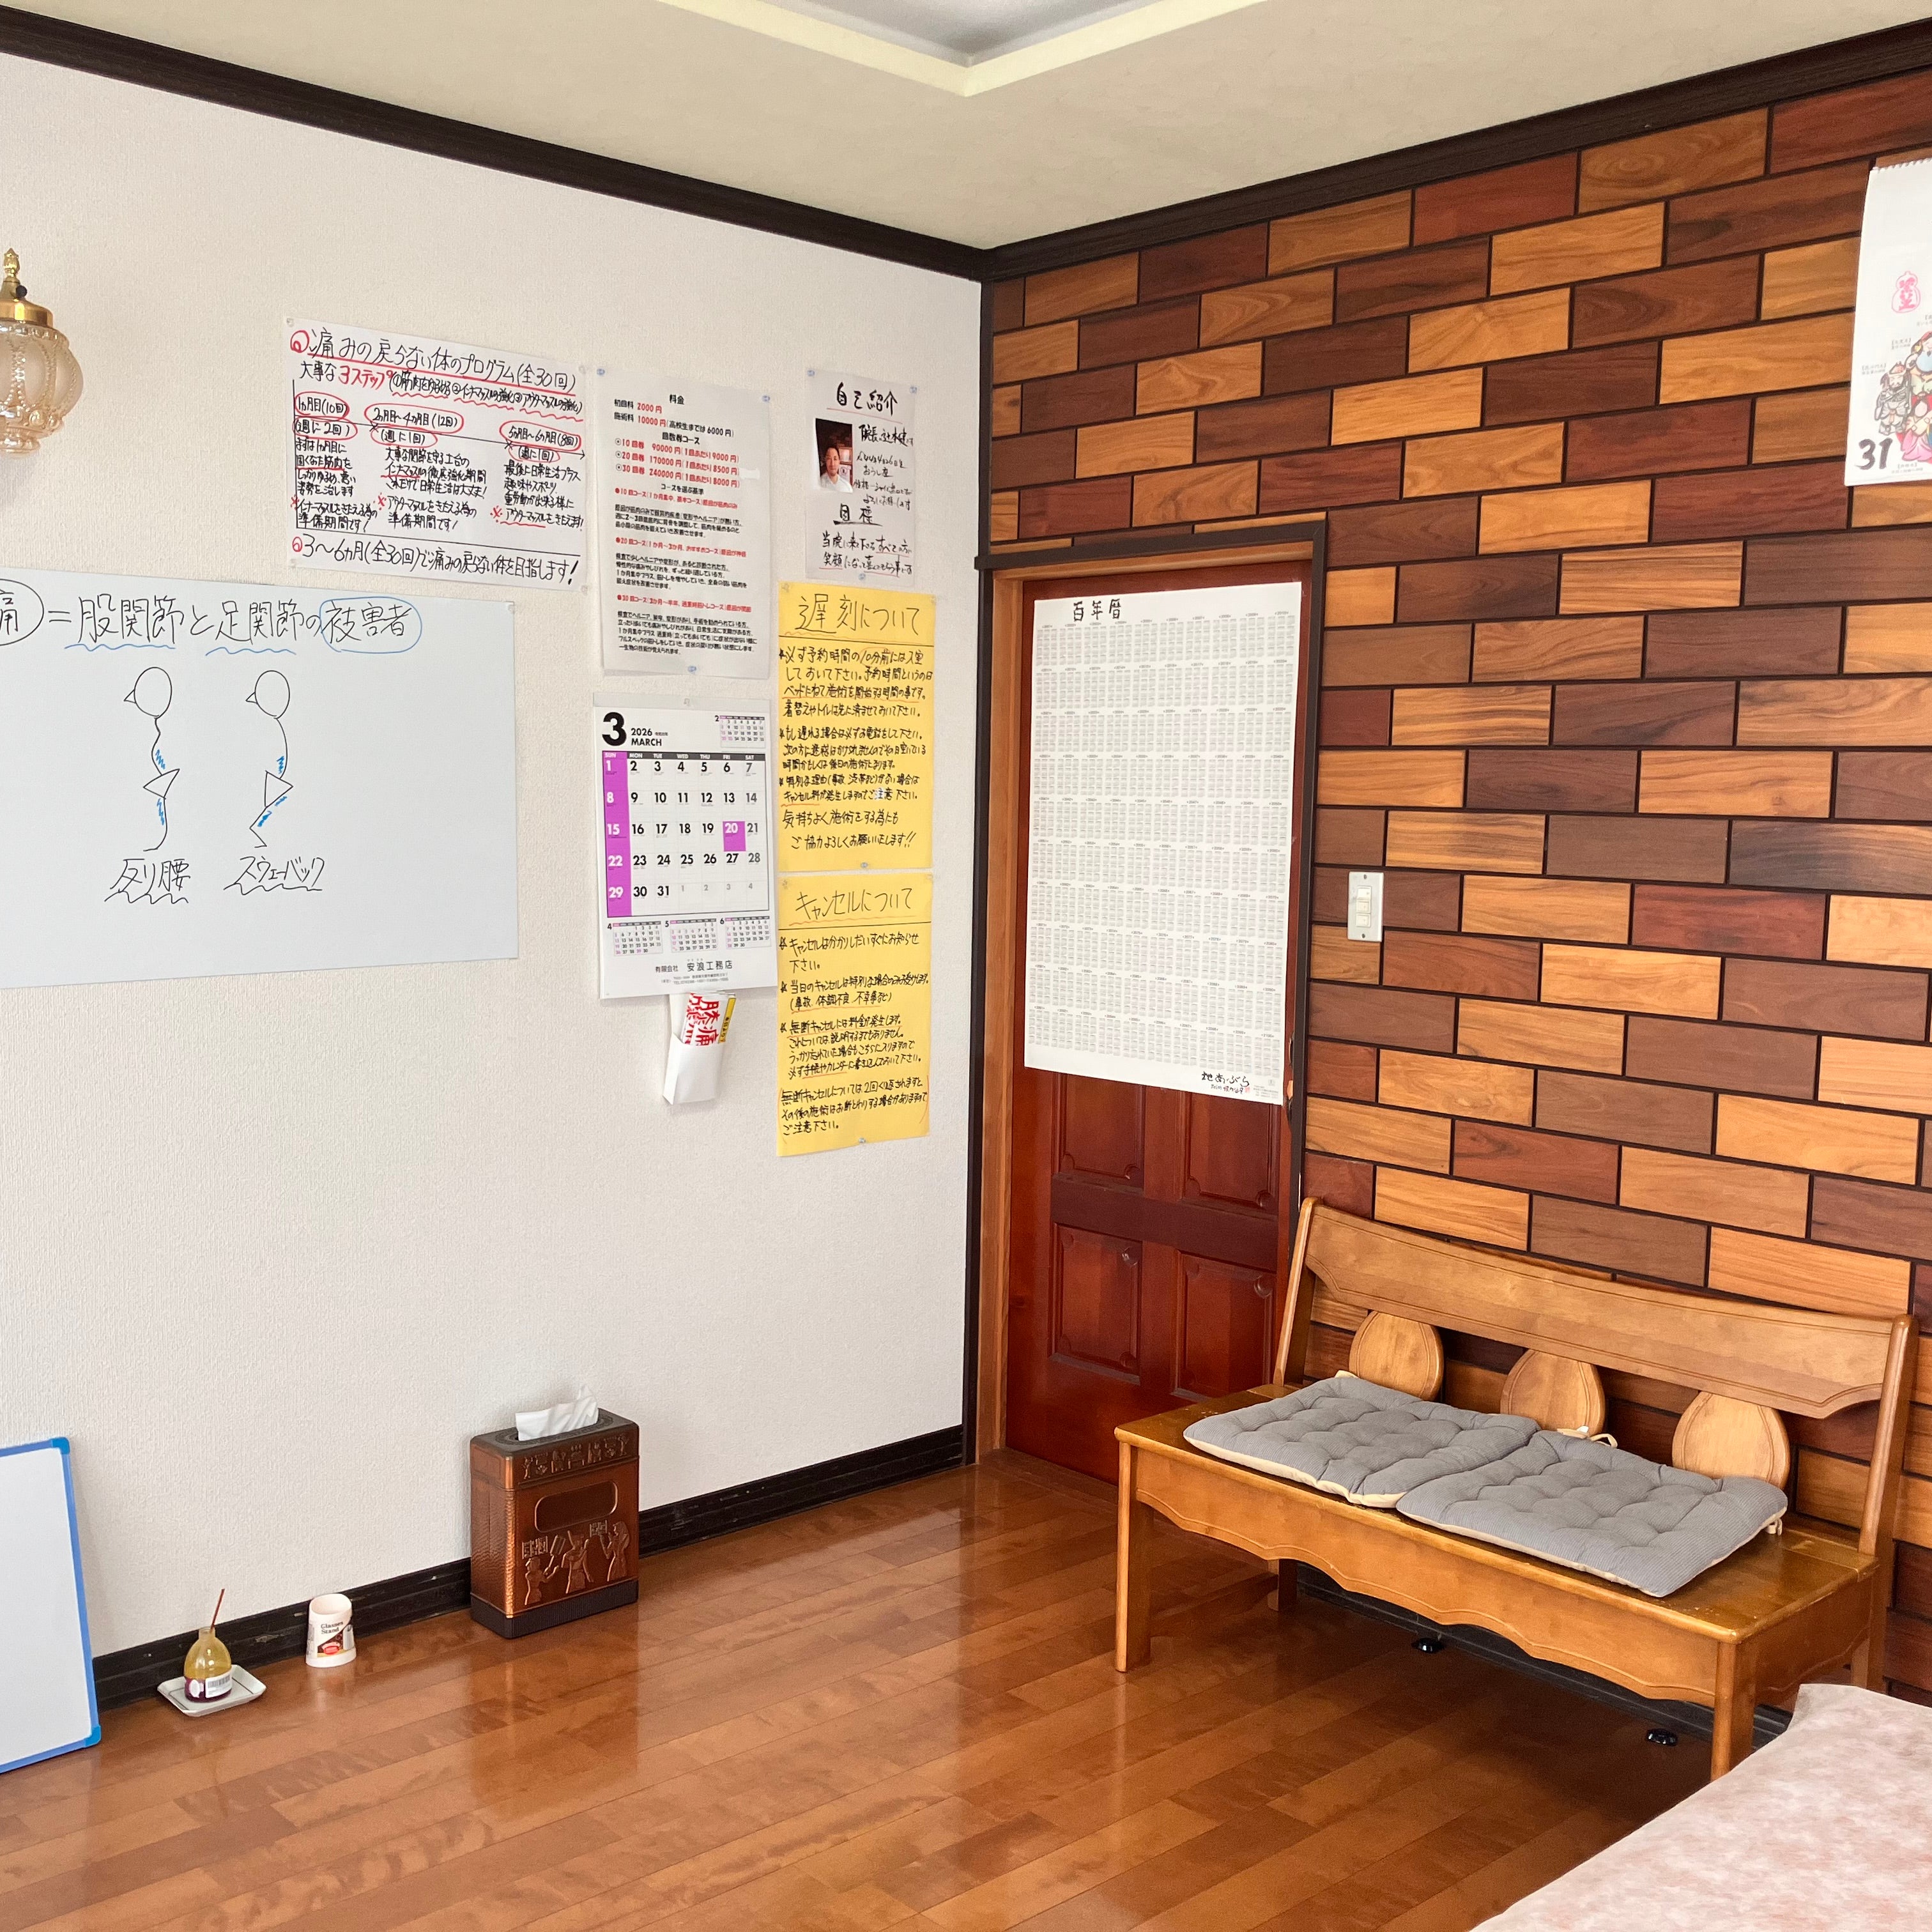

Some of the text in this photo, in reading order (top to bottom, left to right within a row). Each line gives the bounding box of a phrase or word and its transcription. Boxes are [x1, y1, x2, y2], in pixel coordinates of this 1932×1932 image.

[614, 399, 634, 409] 初回料
[670, 394, 684, 404] 料金
[836, 381, 897, 416] 自己紹介
[614, 412, 634, 422] 施術料
[662, 432, 700, 445] 回数券コース
[1855, 438, 1892, 470] 31
[297, 480, 353, 497] 姿勢を治します
[661, 484, 704, 495] コースを選ぶ基準
[839, 503, 873, 523] 目標
[795, 594, 920, 635] 遅刻について
[1073, 598, 1122, 622] 百年暦
[602, 712, 627, 746] 3
[631, 728, 652, 736] 2026
[606, 760, 753, 772] 1 2 3 4 5 6 7
[607, 792, 757, 803] 8 9 10 11 12 13 14
[608, 823, 758, 835] 15 16 17 18 19 20 21
[608, 853, 760, 866] 22 23 24 25 26 27 28
[110, 858, 190, 894] 反り腰
[234, 855, 325, 887] スウェーバック
[609, 887, 624, 898] 29
[633, 886, 647, 897] 30
[657, 886, 669, 896] 31
[795, 888, 912, 920] キャンセルについて
[687, 960, 733, 972] 安浪工務店
[789, 958, 820, 973] 下さい。
[783, 1120, 839, 1136] ご注意下さい。
